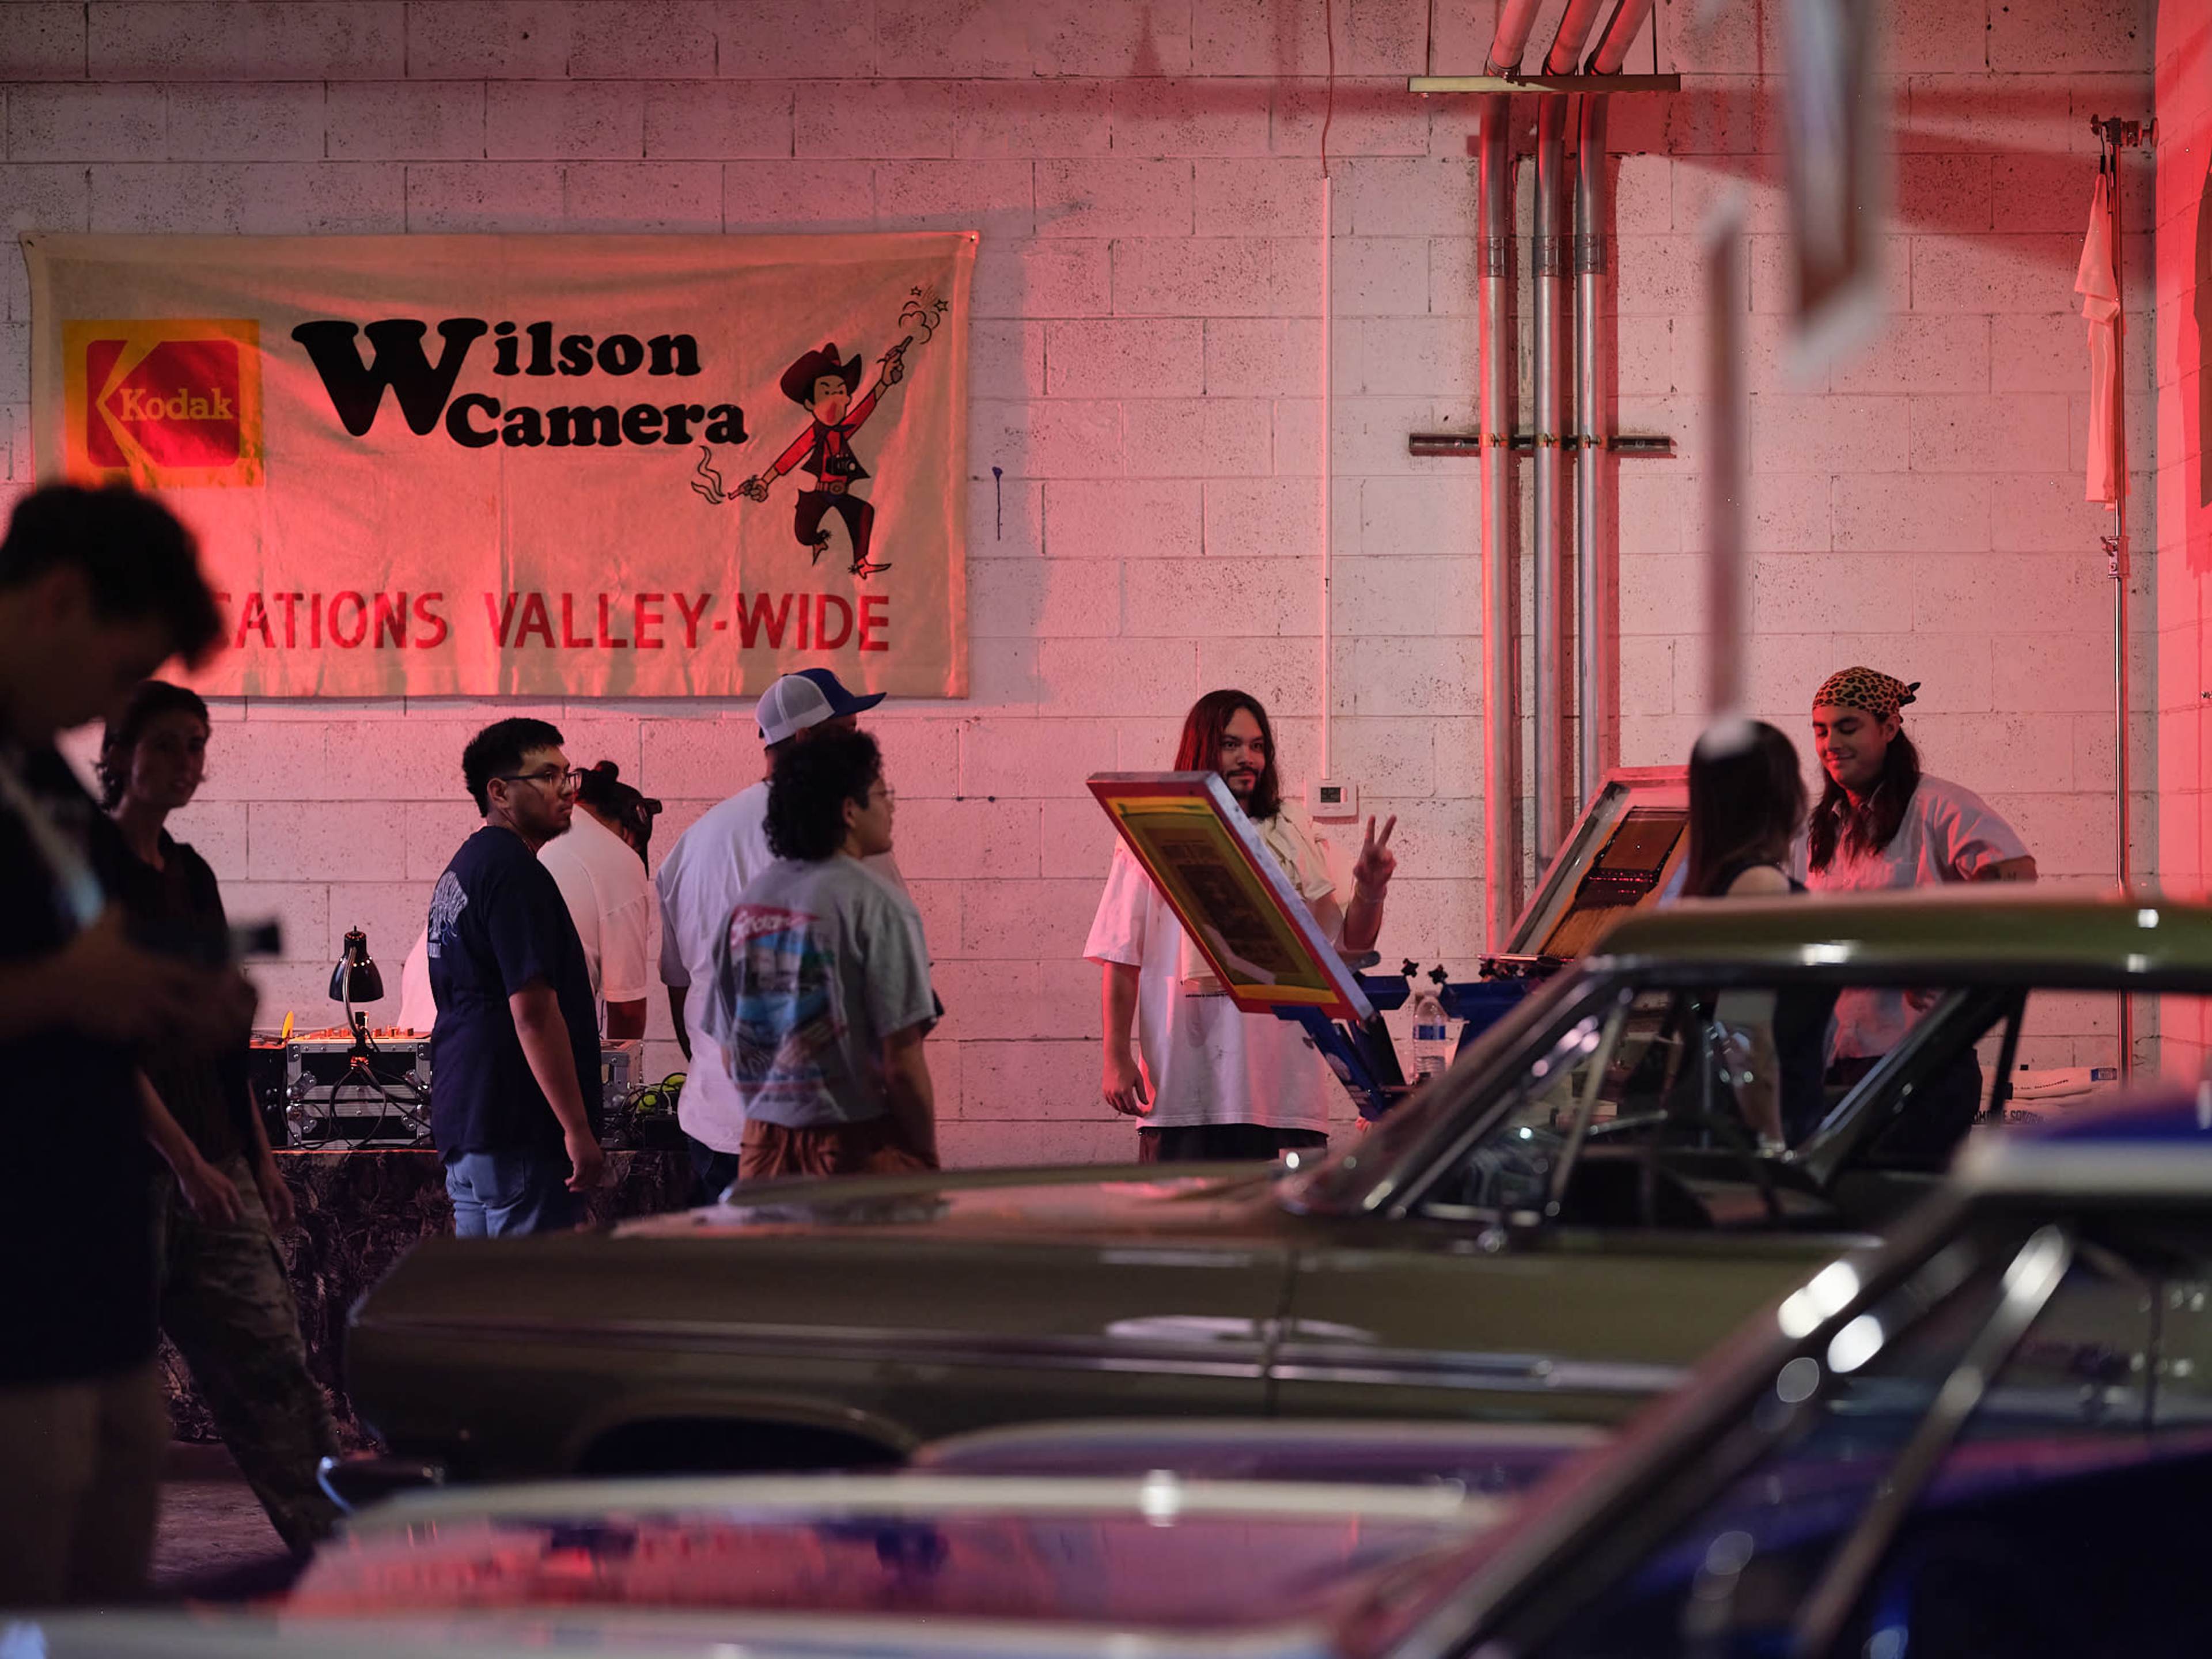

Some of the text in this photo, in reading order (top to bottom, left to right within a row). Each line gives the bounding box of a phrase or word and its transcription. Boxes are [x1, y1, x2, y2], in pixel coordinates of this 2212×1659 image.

[119, 388, 233, 421] Kodak
[291, 318, 702, 436] Wilson
[445, 392, 749, 448] Camera
[214, 591, 890, 652] ATIONS VALLEY-WIDE
